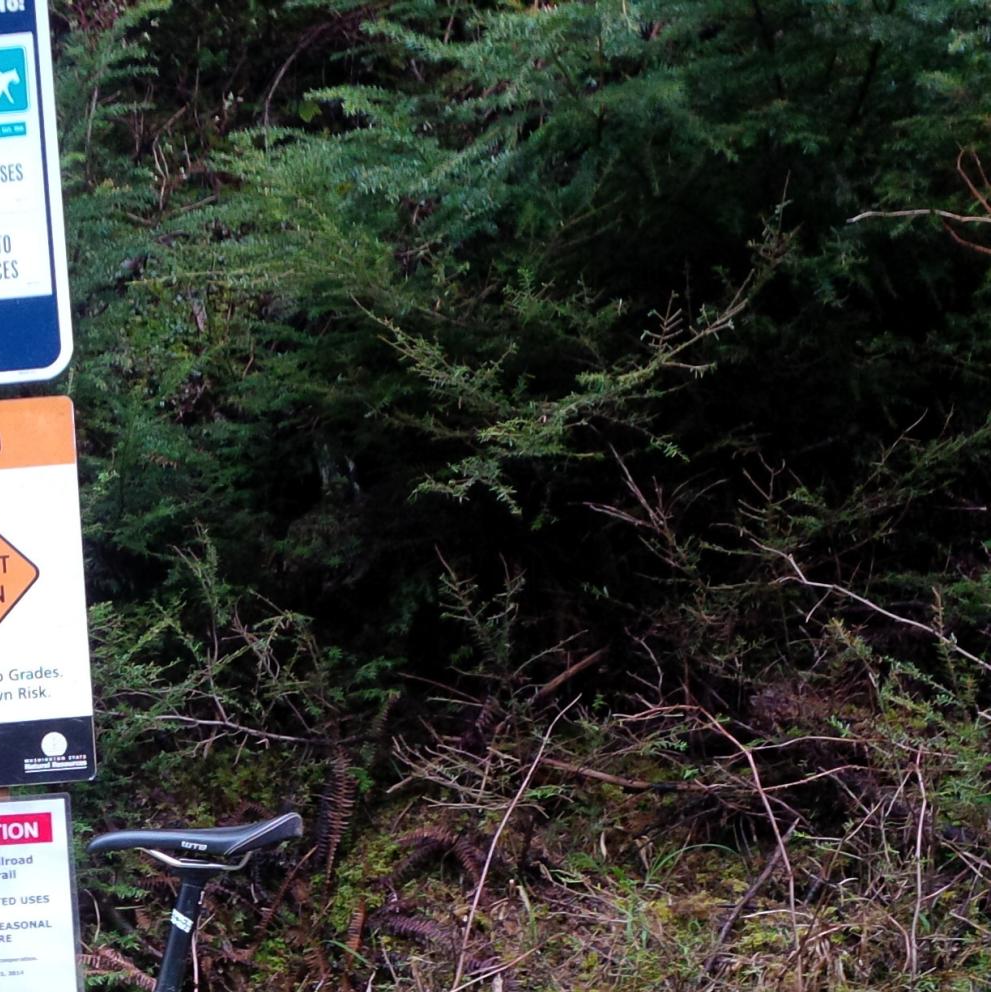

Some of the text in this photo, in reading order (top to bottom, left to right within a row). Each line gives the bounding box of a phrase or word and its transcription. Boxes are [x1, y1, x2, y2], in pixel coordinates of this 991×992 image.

[8, 666, 64, 682] Grades.
[18, 685, 51, 700] Risk.
[20, 894, 50, 905] USES
